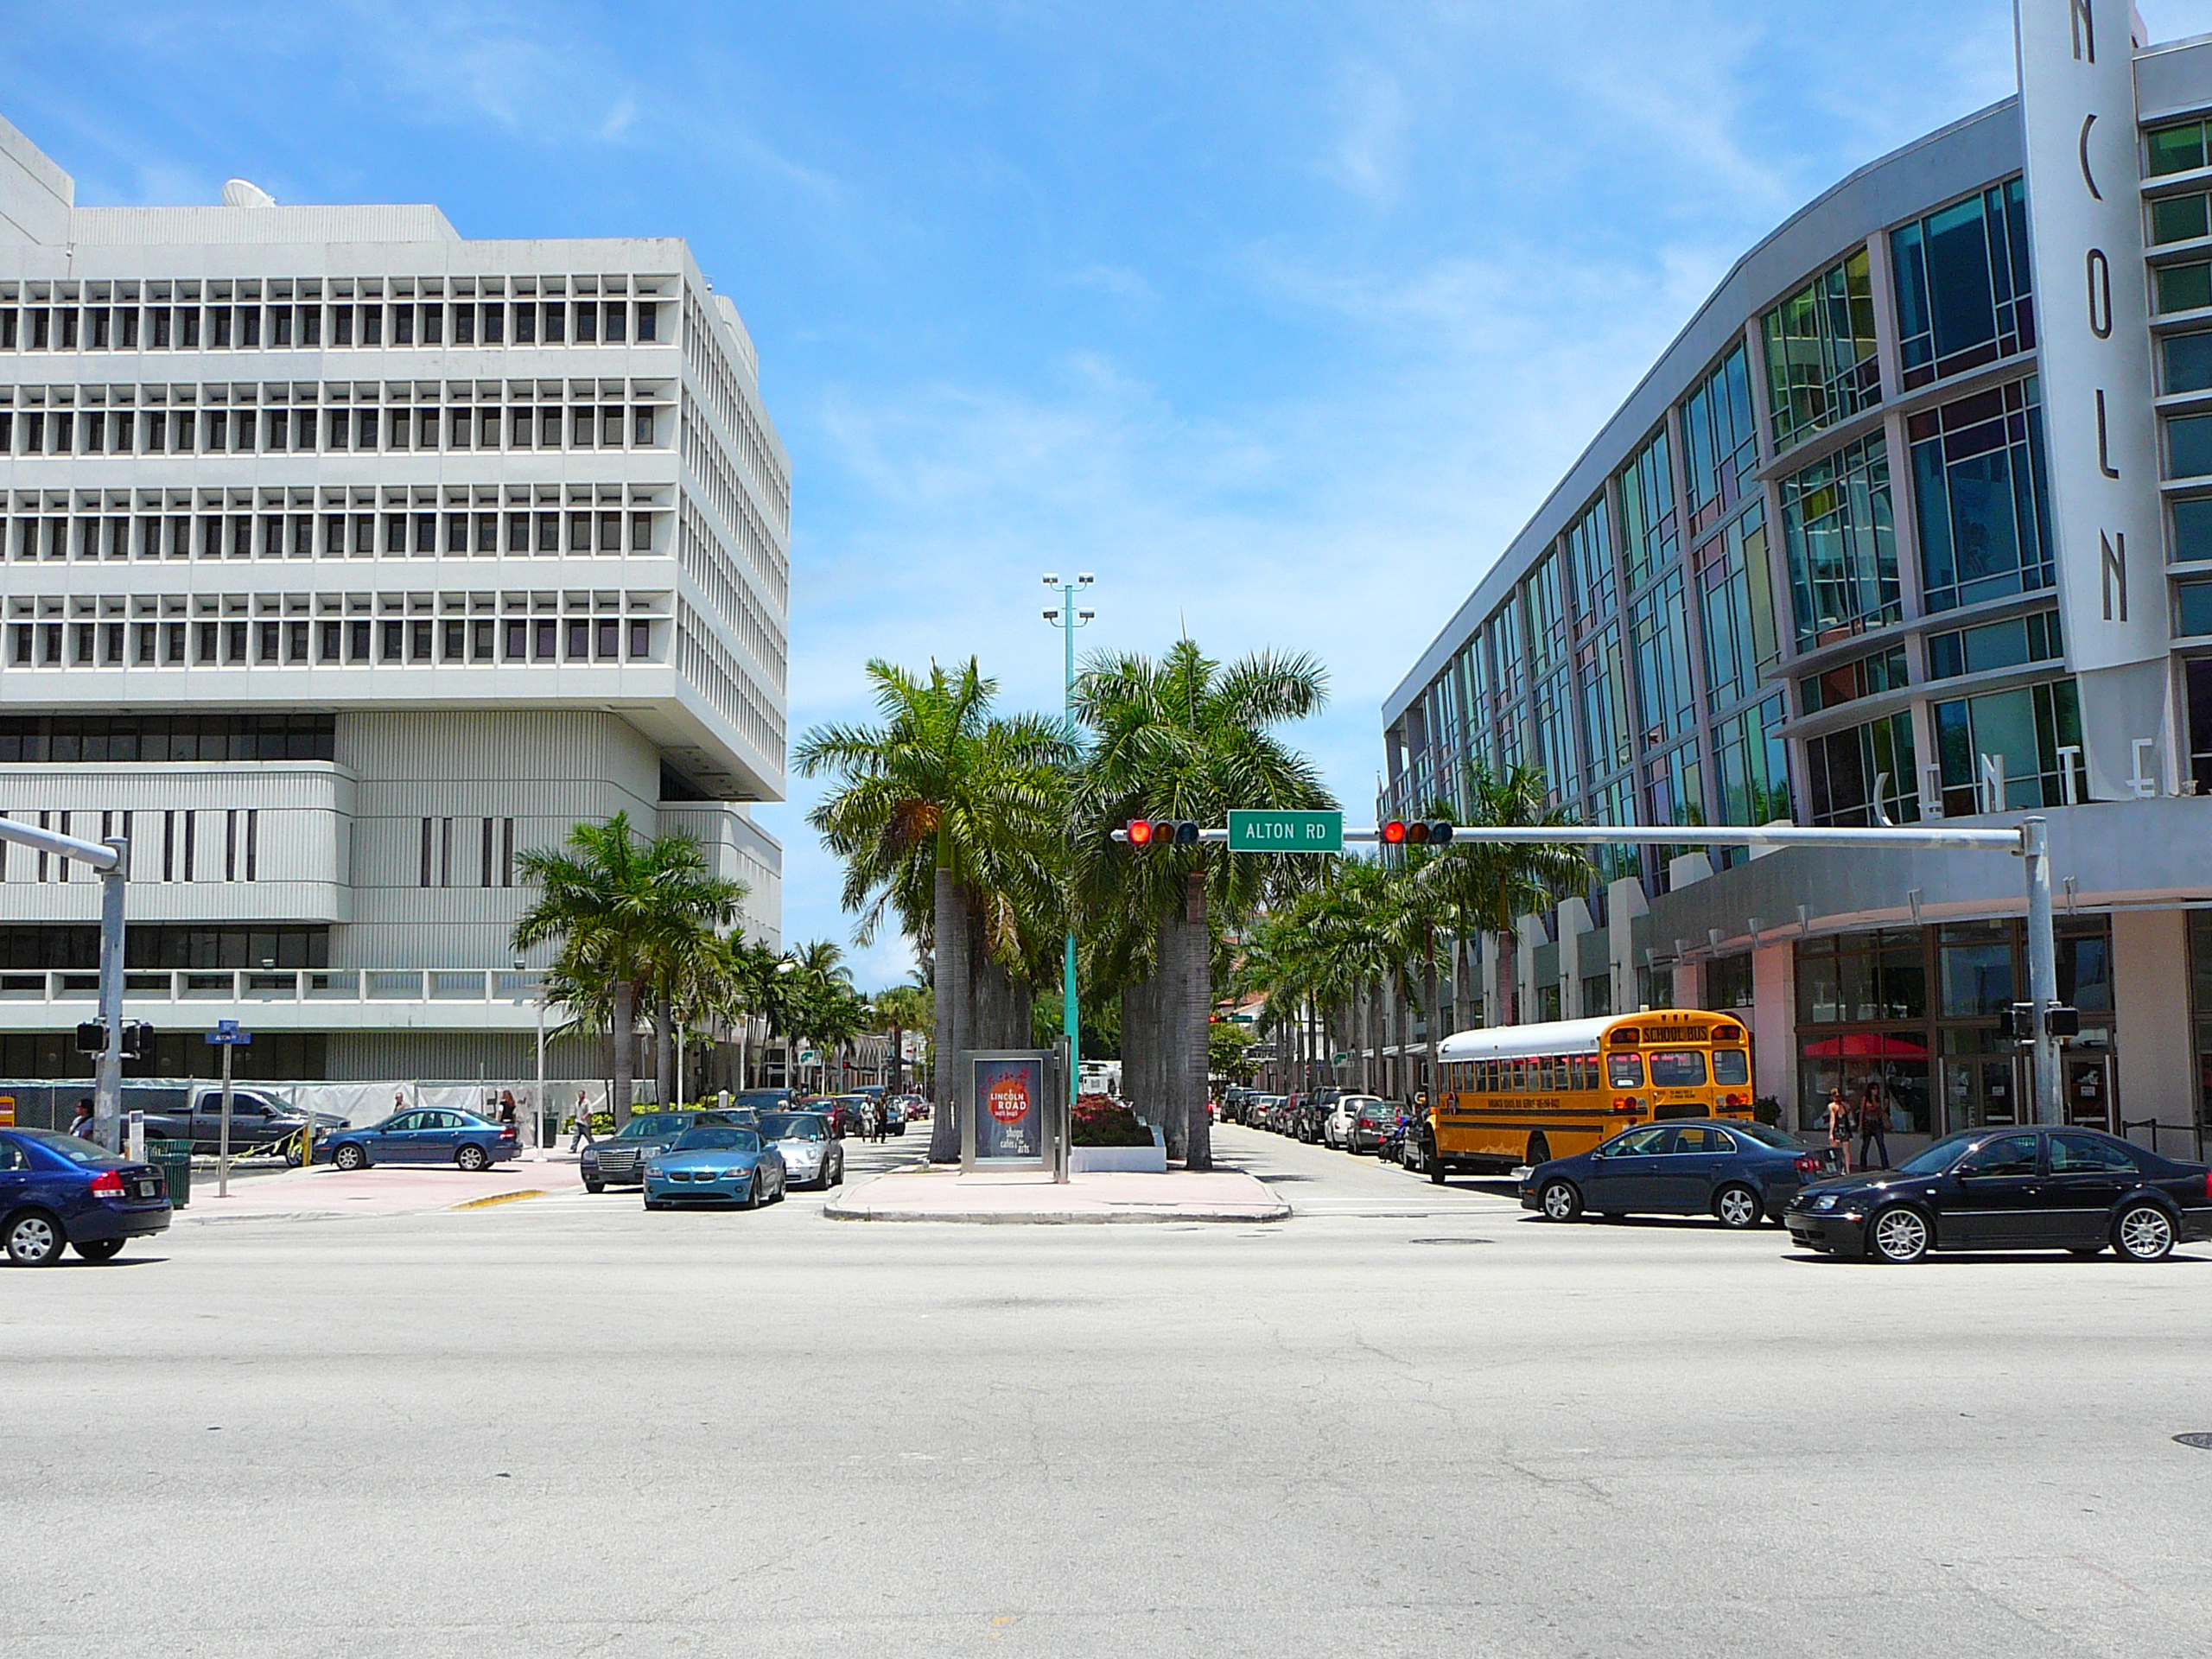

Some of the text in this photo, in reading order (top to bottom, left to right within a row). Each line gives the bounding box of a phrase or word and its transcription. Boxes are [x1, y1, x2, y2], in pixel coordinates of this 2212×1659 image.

[1245, 823, 1325, 839] ALTON RD
[1643, 1026, 1708, 1043] SCHOOL BUS
[1007, 1126, 1024, 1141] shops
[1018, 1143, 1030, 1154] arts
